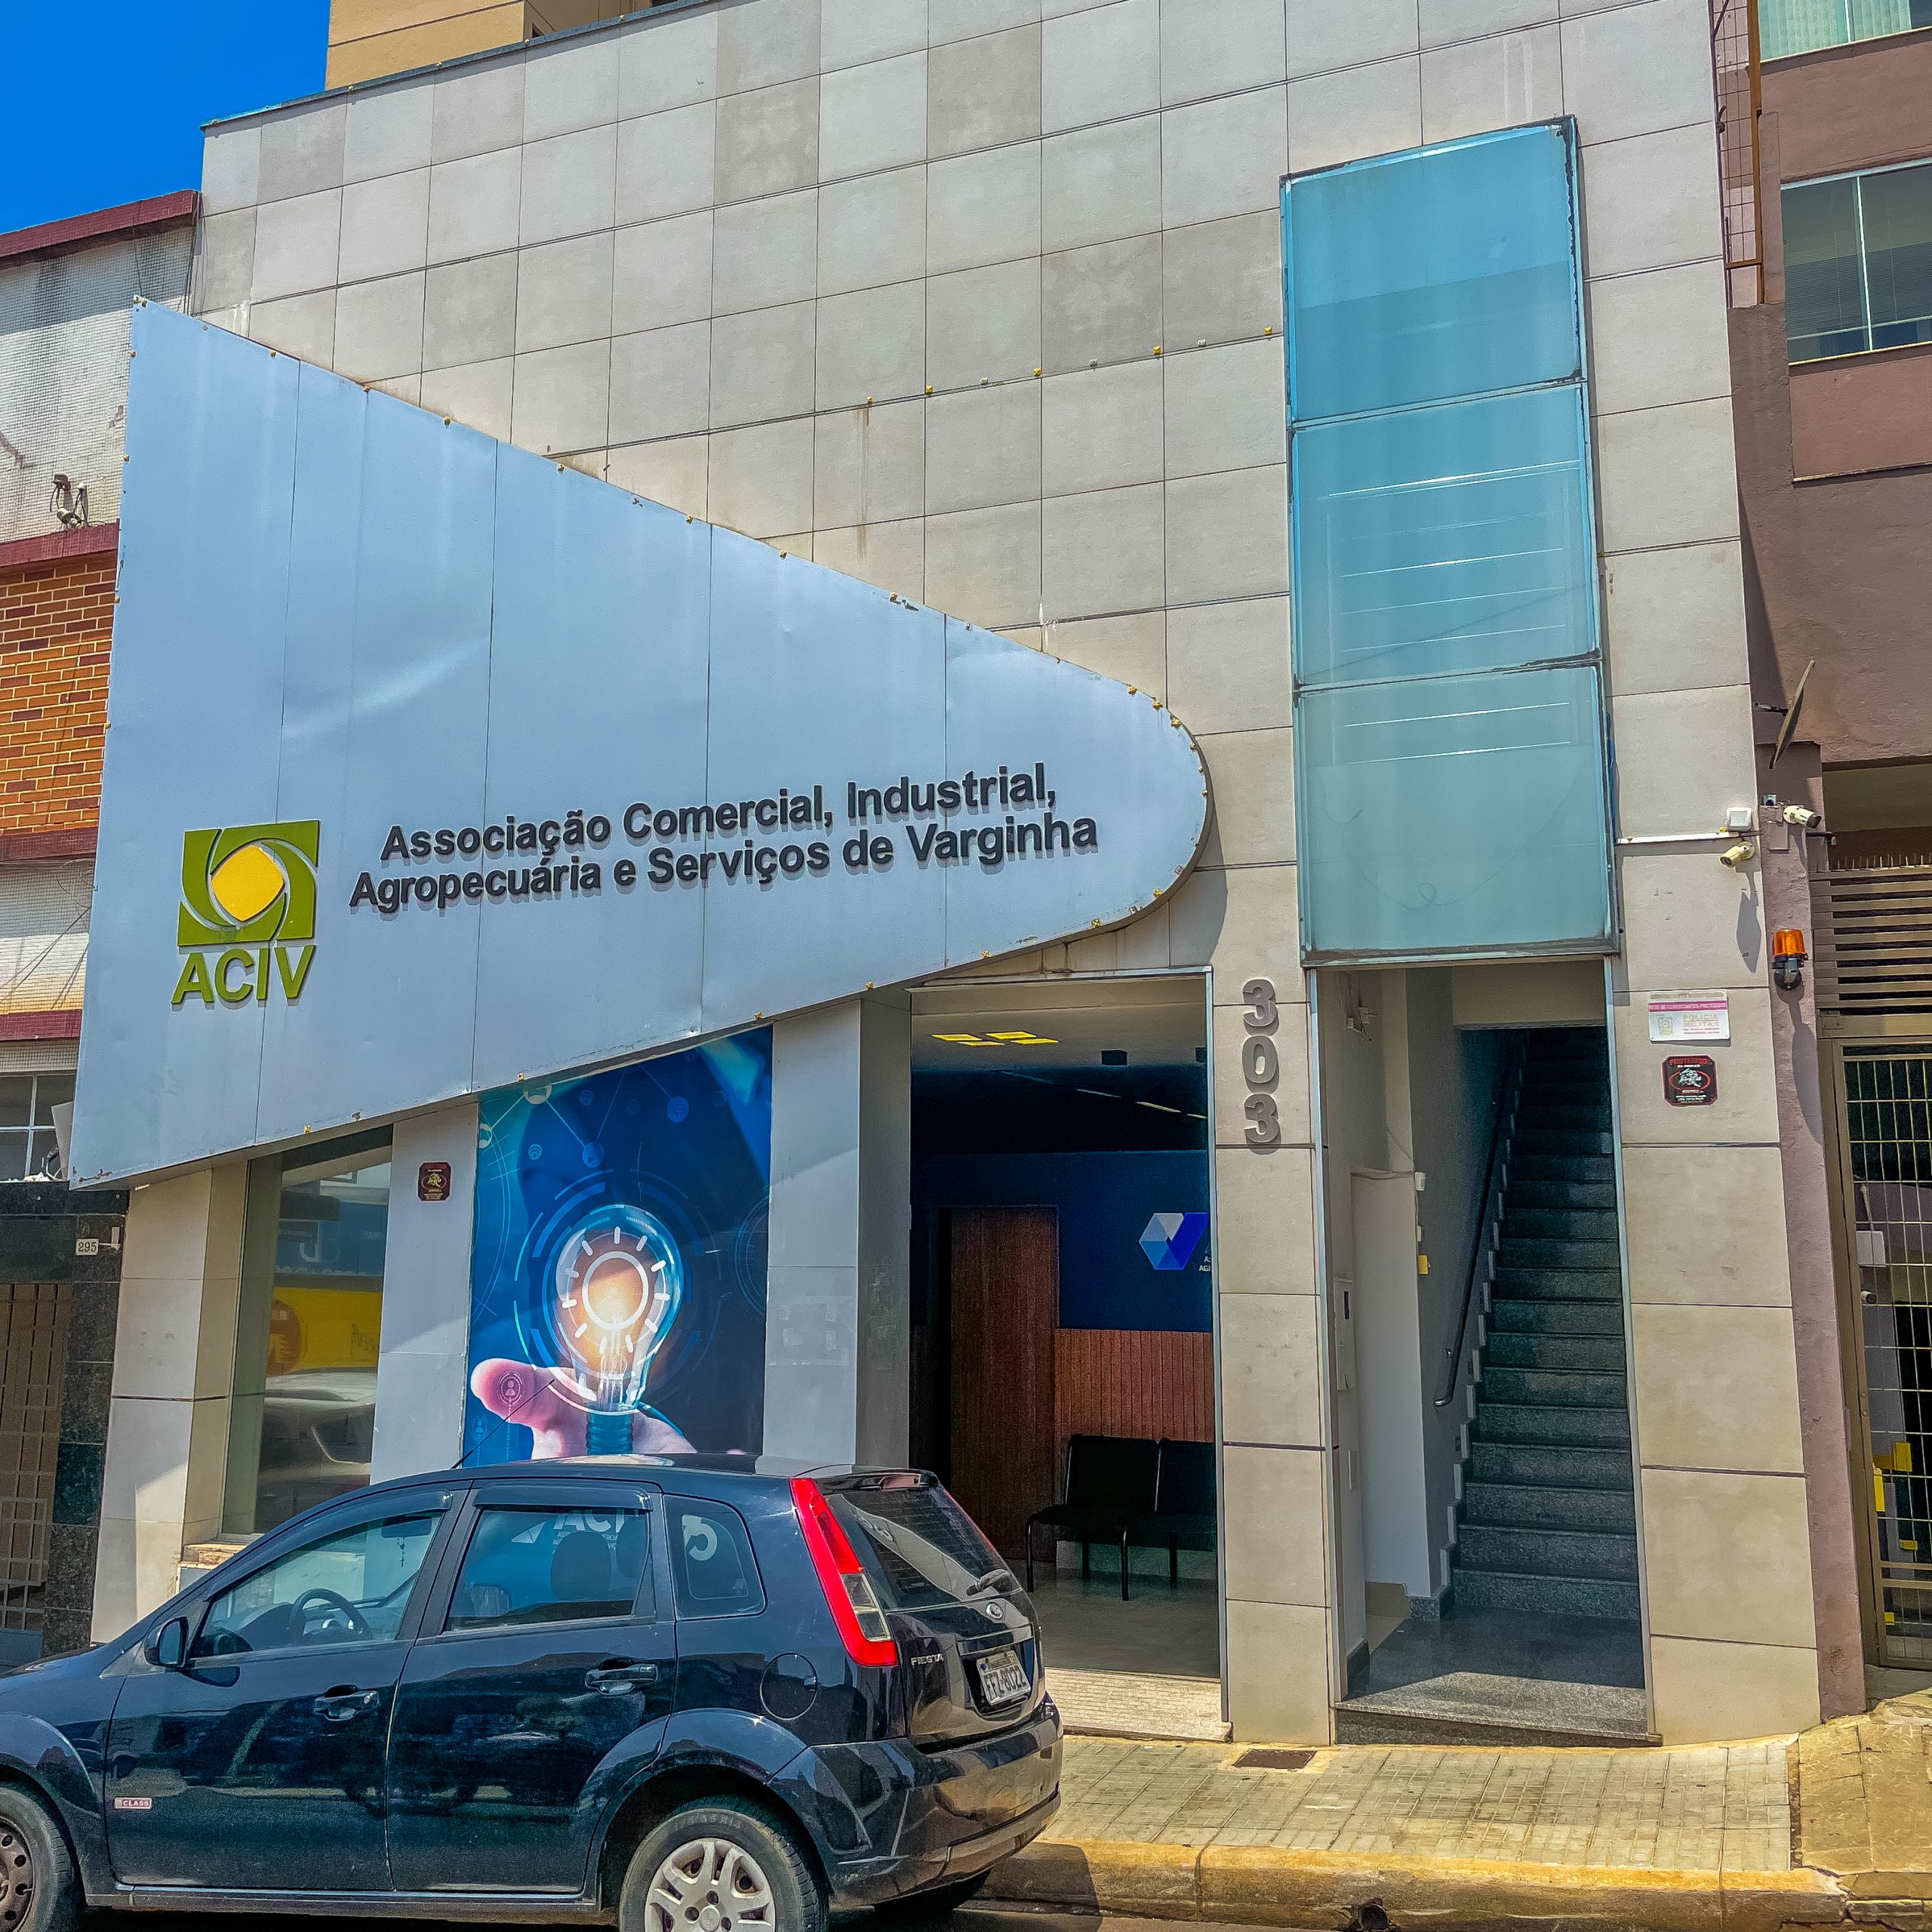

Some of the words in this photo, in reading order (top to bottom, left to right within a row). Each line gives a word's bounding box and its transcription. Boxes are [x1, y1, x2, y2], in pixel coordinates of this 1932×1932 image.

[379, 809, 611, 860] Associação
[623, 785, 833, 839] Comercial,
[847, 762, 1056, 818] Industrial,
[349, 856, 601, 915] Agropecuária
[614, 858, 636, 887] e
[648, 840, 830, 884] Serviços
[843, 829, 894, 868] de
[906, 812, 1097, 866] Varginha
[171, 944, 316, 1004] ACIV
[1242, 979, 1281, 1143] 303
[77, 1241, 97, 1253] 295
[910, 1654, 944, 1666] FIESTA
